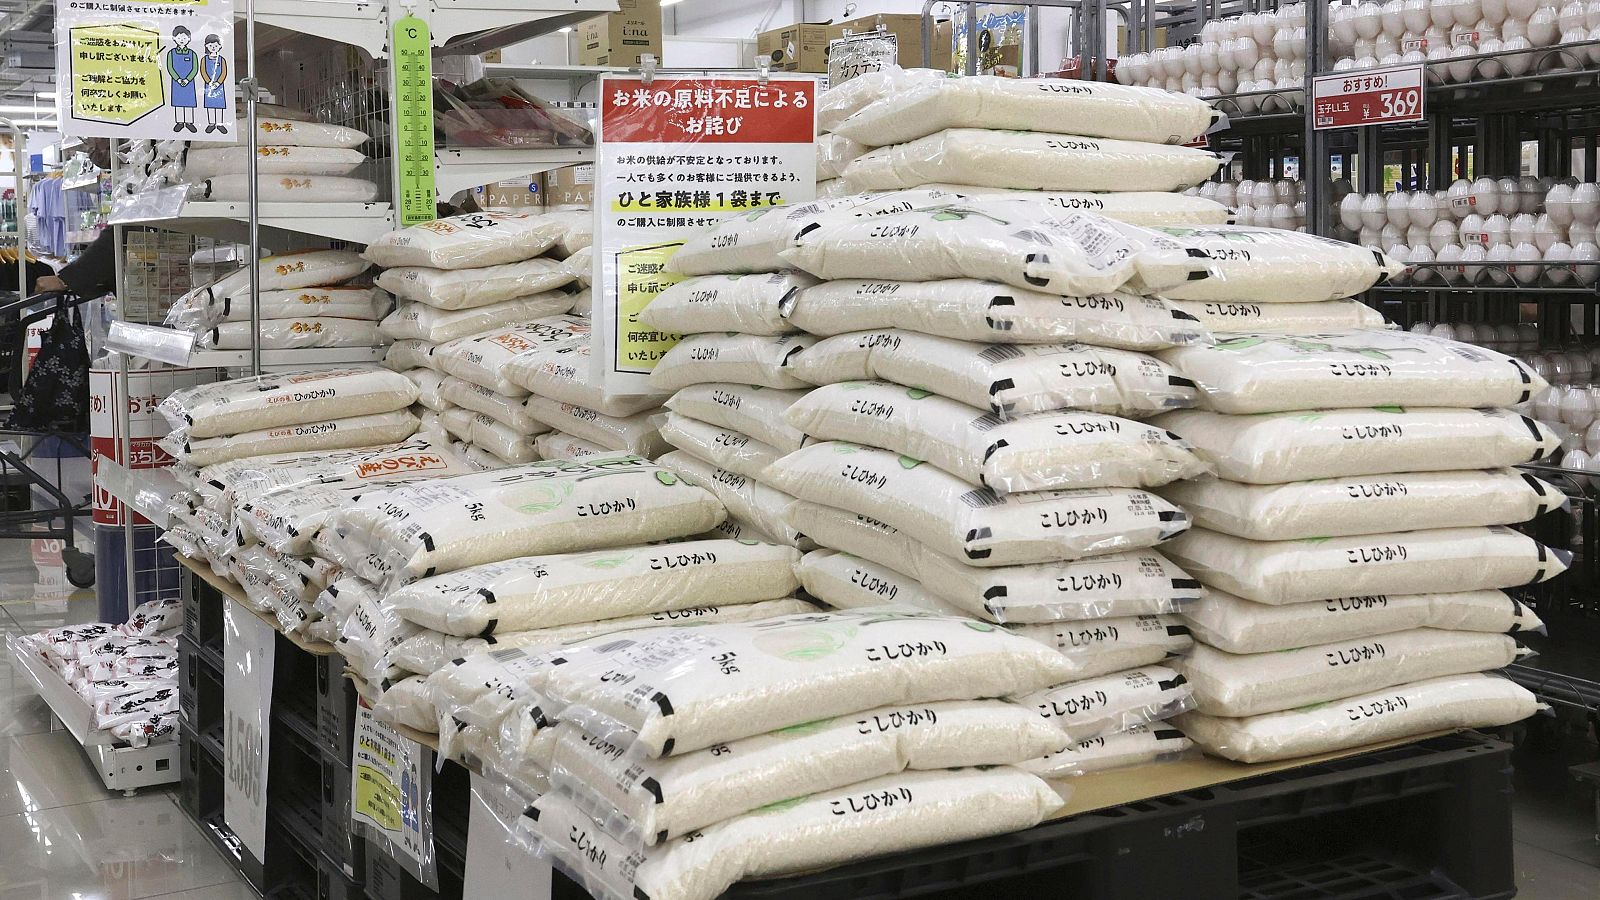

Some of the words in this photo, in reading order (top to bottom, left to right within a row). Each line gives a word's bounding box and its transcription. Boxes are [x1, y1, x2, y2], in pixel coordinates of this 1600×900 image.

[1343, 75, 1388, 93] おすすめ!
[613, 89, 808, 109] お米の原料不足による
[1318, 102, 1350, 114] 玉子LL玉
[1381, 90, 1419, 118] 369
[686, 116, 743, 135] お詫び
[617, 155, 784, 166] お米の供給が不安定となっております。
[617, 173, 802, 183] 一人でも多くのお客様にご提供できるよう、
[1206, 303, 1261, 317] こしひかり
[1061, 361, 1116, 378] こしひかり
[1330, 363, 1392, 377] こしひかり
[294, 388, 336, 401] ひのひかり
[852, 399, 894, 419] こしひかり
[295, 422, 337, 436] ひのひかり
[1055, 421, 1120, 436] こしひかり
[1342, 423, 1403, 439] こしひかり
[842, 464, 887, 489] こしひかり
[1349, 481, 1408, 499] こしひかり
[577, 497, 637, 517] こしひかり
[1040, 507, 1108, 528] こしひかり
[650, 551, 716, 570] こしひかり
[1347, 545, 1408, 563] こしひかり
[851, 569, 898, 599] こしひかり
[1056, 573, 1122, 592] こしひかり
[1056, 625, 1119, 648] こしひかり
[866, 641, 947, 662] こしひかり
[1326, 643, 1385, 666] こしひかり
[1038, 691, 1107, 718] こしひかり
[1347, 696, 1408, 720] こしひかり
[857, 709, 937, 735] こしひかり
[831, 787, 912, 815] こしひかり
